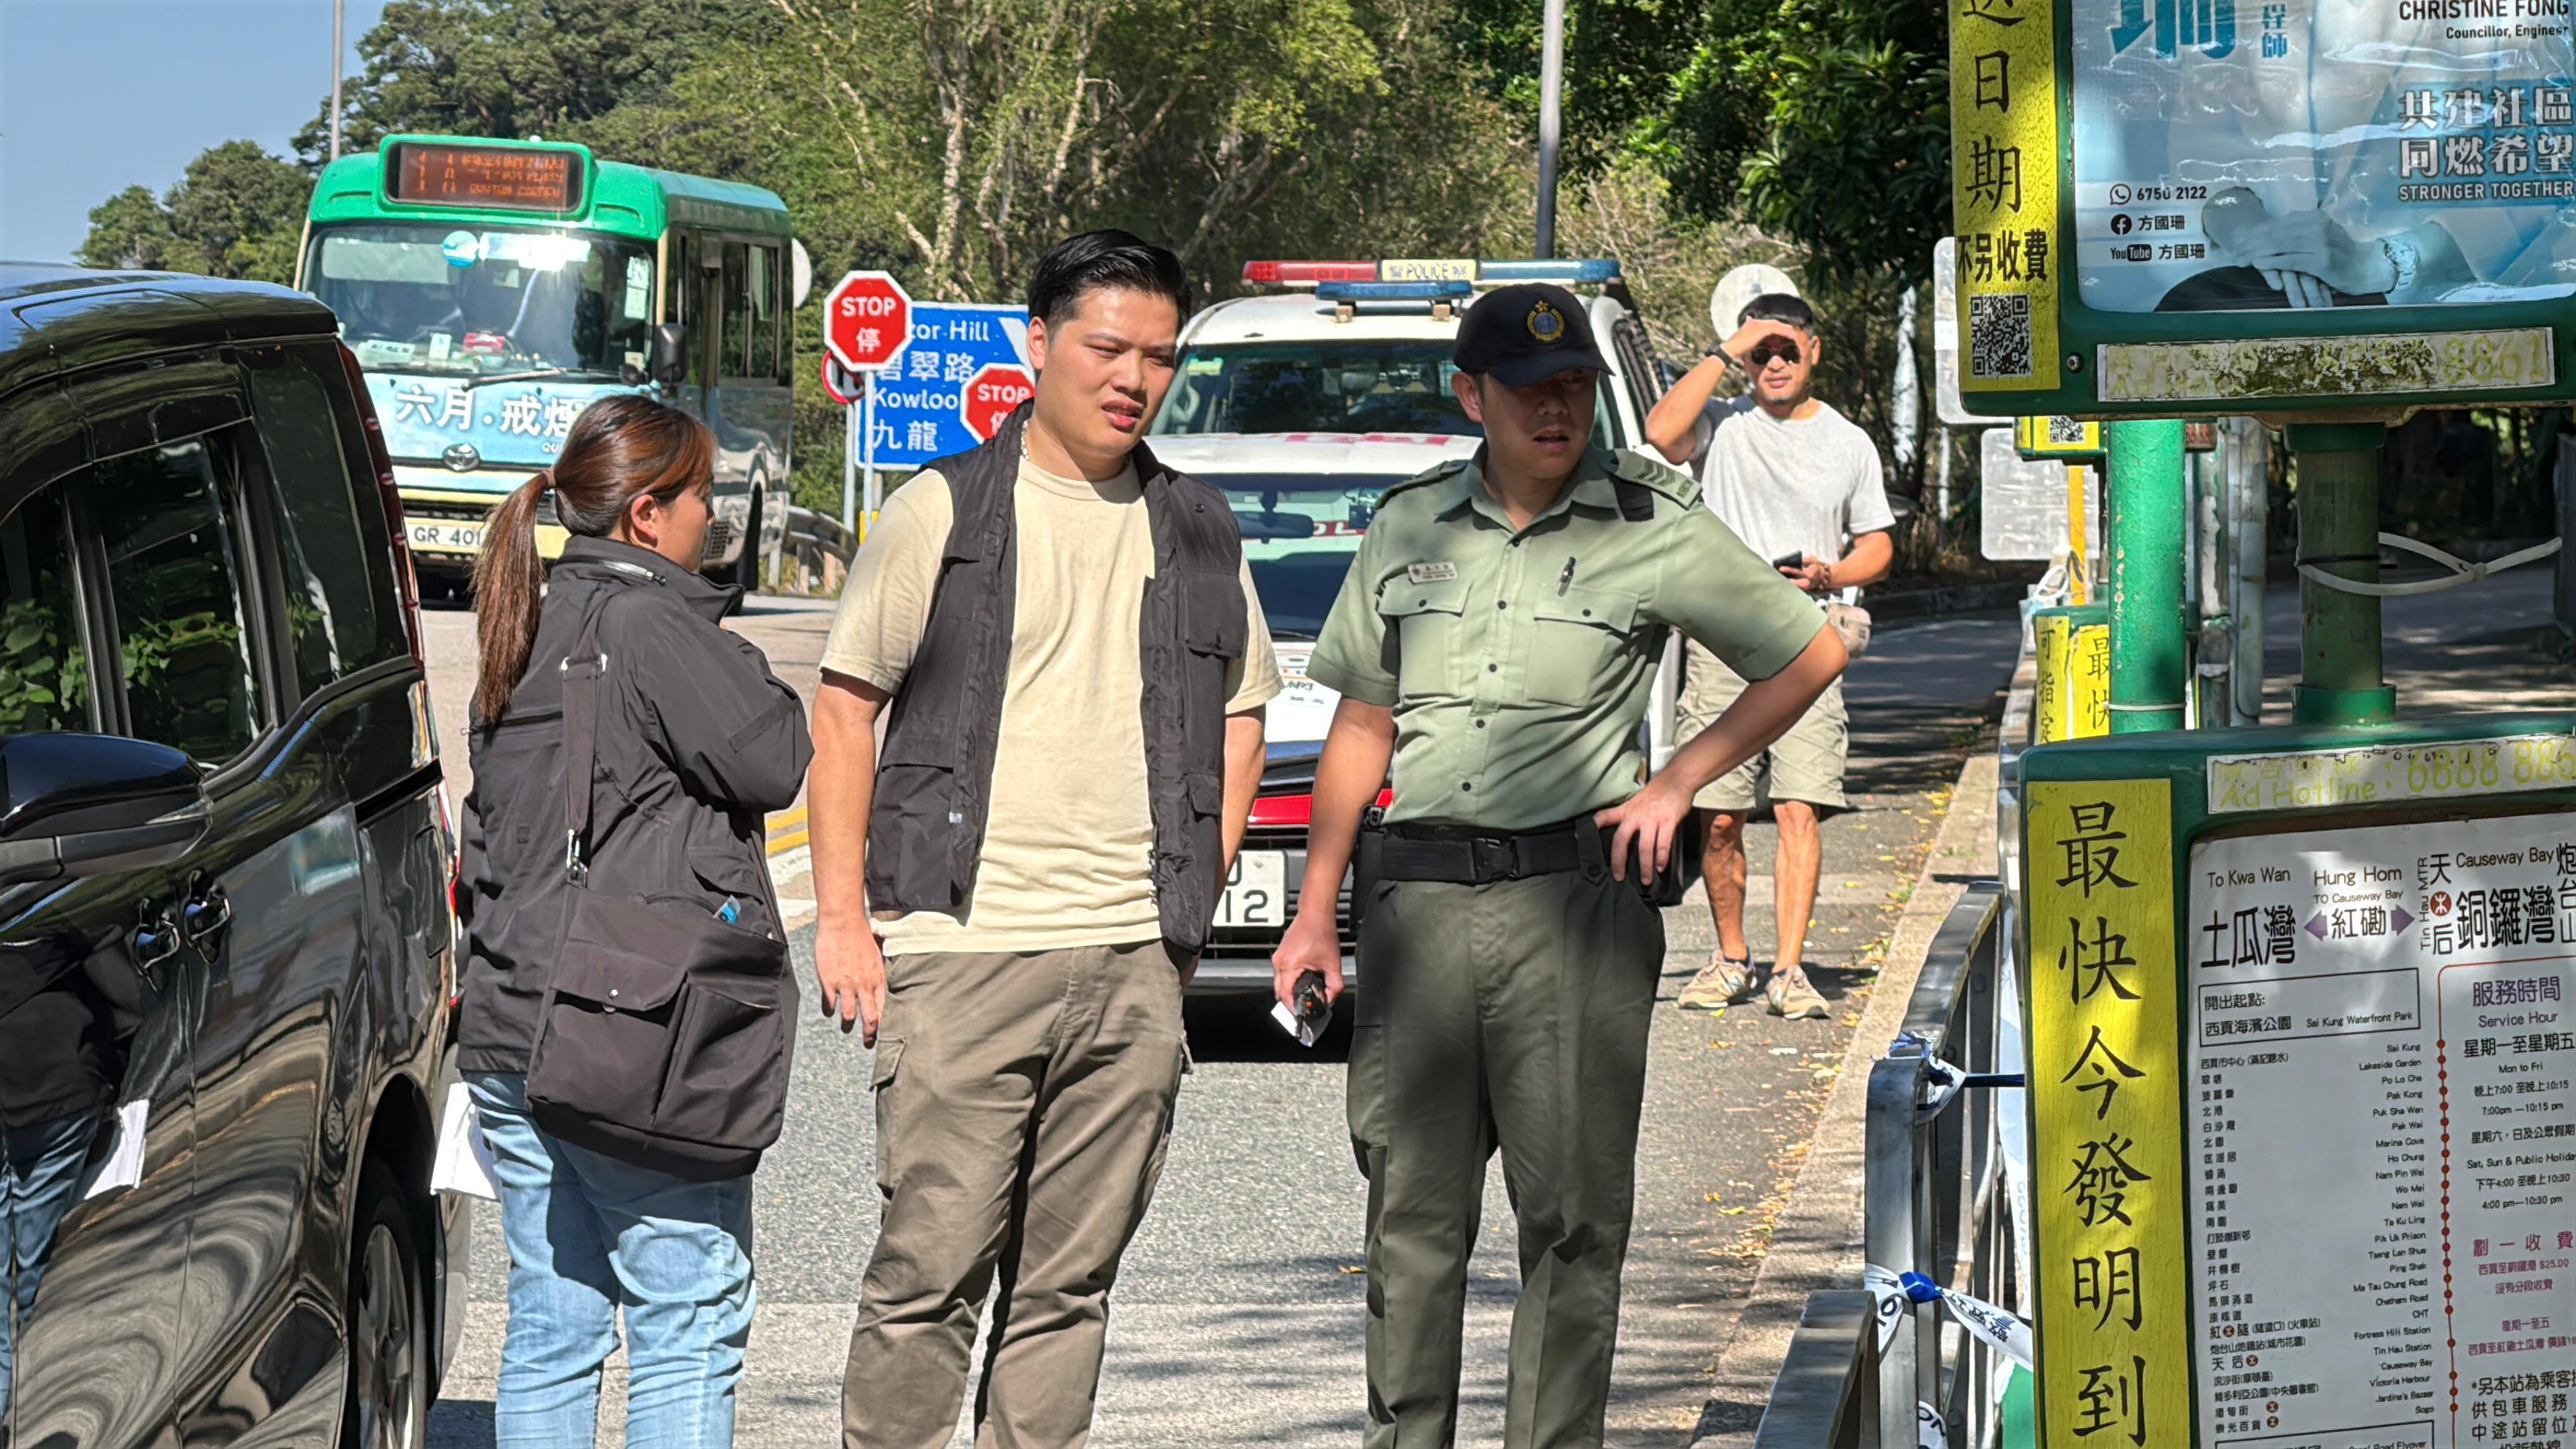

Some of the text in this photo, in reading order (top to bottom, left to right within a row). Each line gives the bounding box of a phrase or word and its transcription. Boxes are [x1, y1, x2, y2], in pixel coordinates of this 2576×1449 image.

[2400, 0, 2569, 20] CHRISTINE FONG
[2446, 25, 2569, 39] Councillor, Engineer
[2400, 88, 2572, 130] 共建社區
[2400, 134, 2574, 178] 同燃希望
[2137, 186, 2208, 201] 6750 2122
[2400, 181, 2574, 201] STRONGER TOGETHER
[2138, 214, 2185, 231] 方國珊
[1957, 228, 2048, 285] 不另收費
[2159, 243, 2206, 261] 方國珊
[1407, 263, 1448, 281] POLICE
[842, 296, 896, 318] STOP
[856, 327, 881, 353] 停
[950, 320, 989, 342] Hill
[874, 387, 959, 411] Kowloo
[978, 383, 1030, 404] STOP
[874, 419, 937, 452] 九龍
[414, 527, 483, 546] GR 401
[2407, 747, 2499, 793] 6888
[2456, 847, 2555, 869] Causeway Bay
[2207, 866, 2291, 888] To Kwa Wan
[2314, 866, 2403, 887] Hung Hom
[1225, 890, 1269, 924] 12
[2314, 889, 2404, 905] TO Causeway Bay
[2417, 856, 2431, 951] Tin Hau MTR
[2332, 905, 2387, 940] 紅磡
[2456, 886, 2555, 950] 銅鑼灣
[2201, 905, 2296, 968] 土瓜灣
[2473, 976, 2561, 1007] 服務時間
[2205, 1016, 2292, 1037] 西貢海濱公園
[2307, 1011, 2414, 1028] Sai Kung Waterfront Park
[2479, 1011, 2558, 1028] Service Hour
[2464, 1033, 2575, 1058] 星期一至星期五
[2498, 1062, 2543, 1074] Mon to Fri
[2551, 1103, 2564, 1112] pm
[2056, 801, 2152, 1448] 最快今發明到
[2487, 1158, 2503, 1167] Sun
[2506, 1157, 2512, 1166] &
[2515, 1154, 2543, 1165] Public
[2550, 1196, 2563, 1205] pm
[2539, 1259, 2569, 1270] $25.00
[2472, 1393, 2567, 1419] 供包車服務
